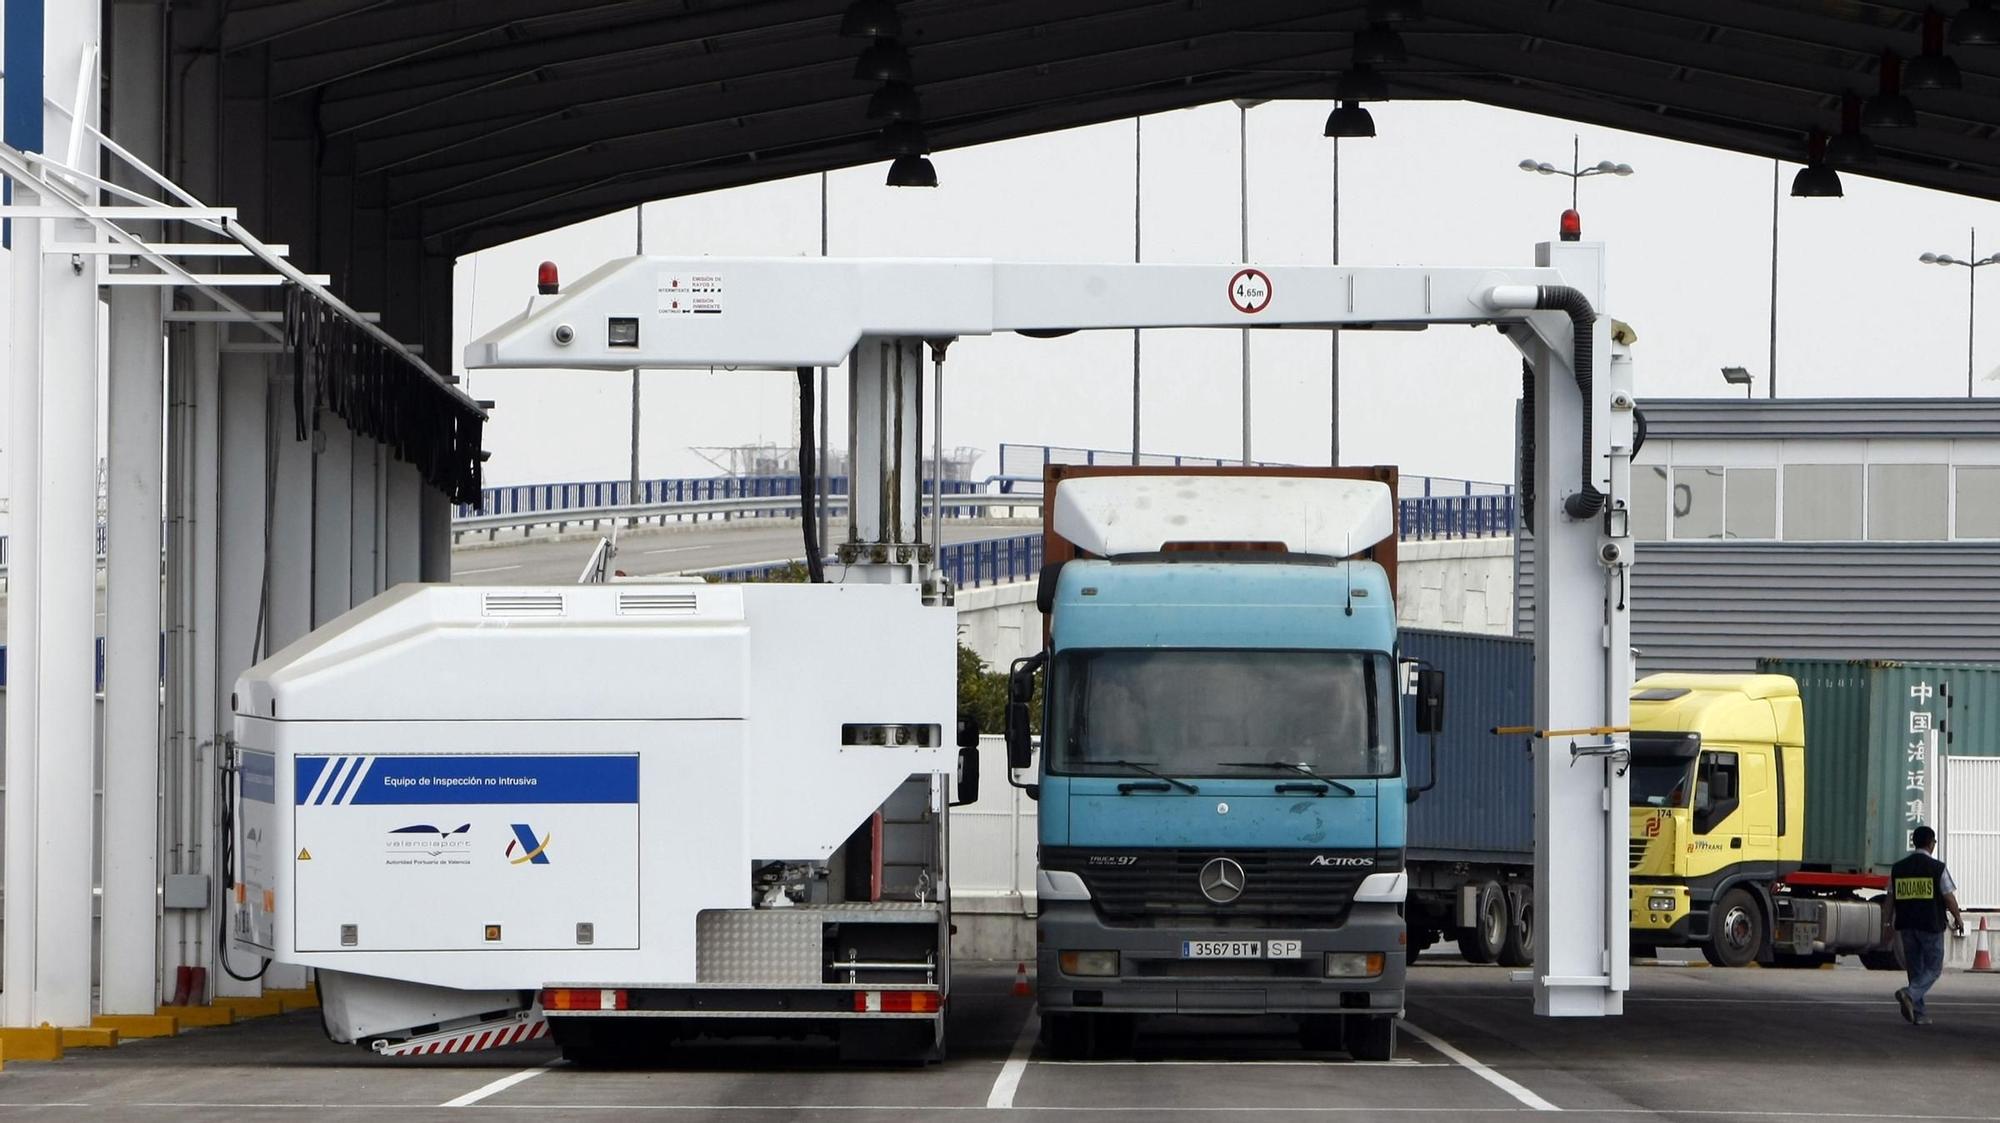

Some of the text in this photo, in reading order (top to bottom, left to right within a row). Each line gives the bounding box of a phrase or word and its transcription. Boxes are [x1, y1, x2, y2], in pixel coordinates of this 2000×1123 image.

[384, 776, 417, 788] Equipo
[418, 776, 431, 786] de
[433, 776, 483, 788] Inspección
[484, 778, 497, 786] no
[1117, 856, 1138, 865] 97
[1897, 880, 1933, 897] ADUANAS
[1195, 943, 1229, 956] 3567
[1232, 943, 1258, 956] BTW
